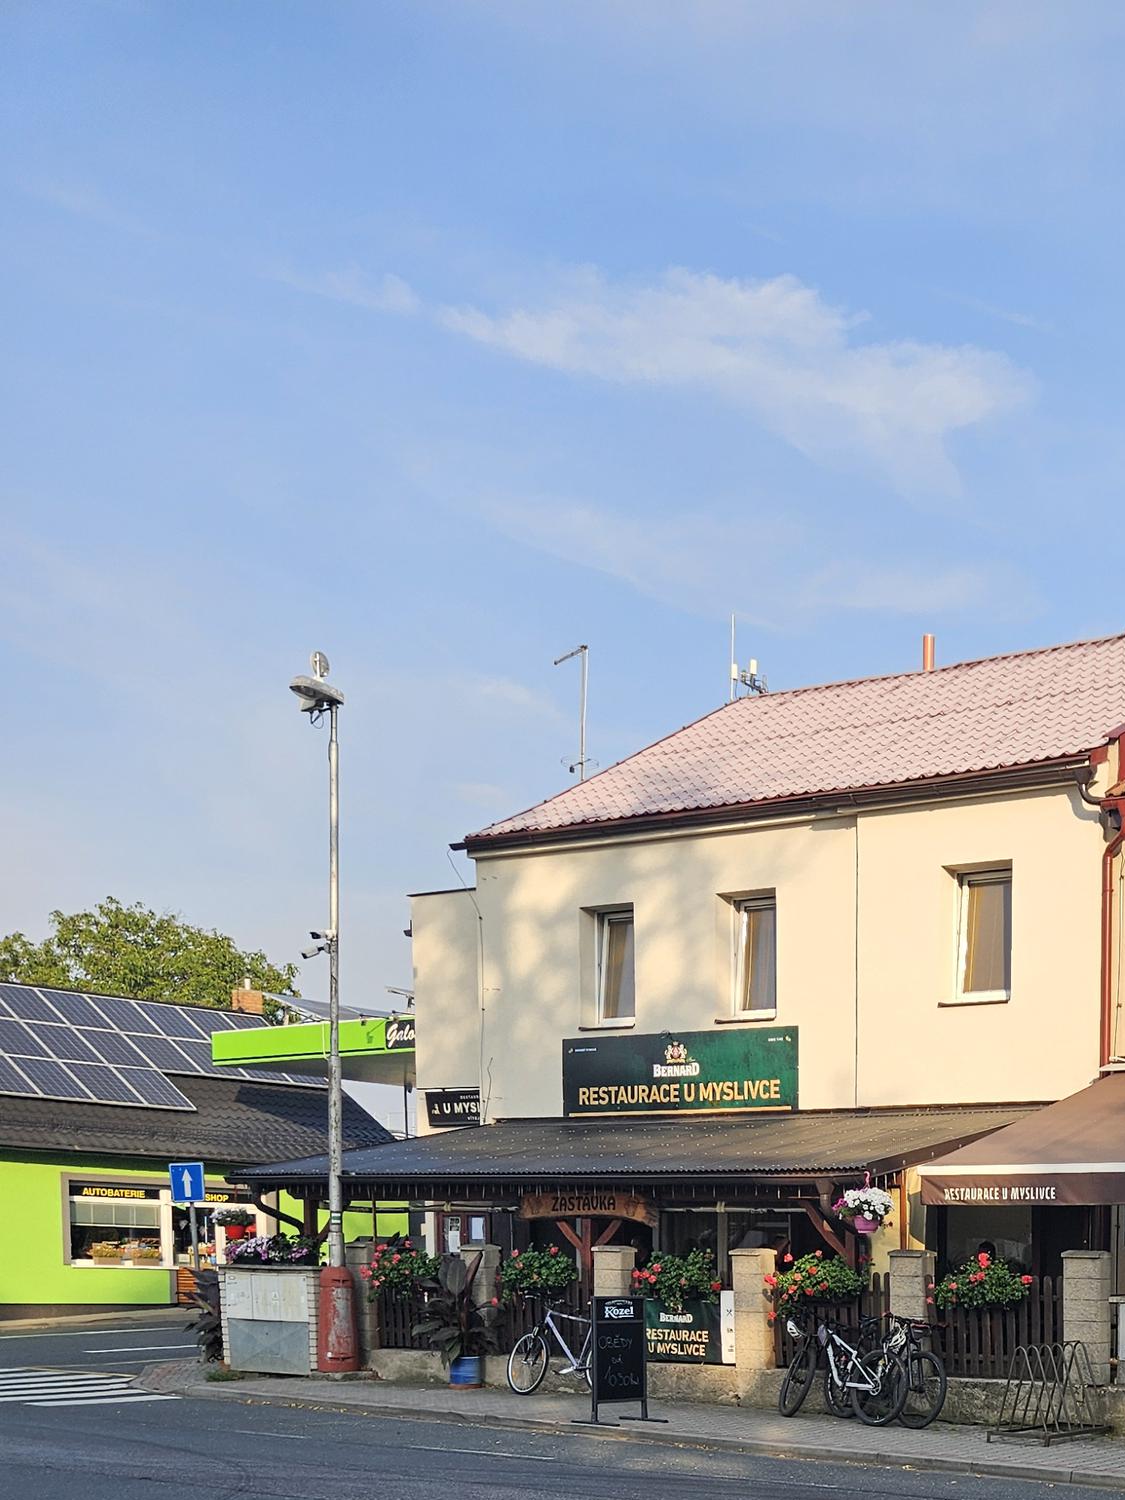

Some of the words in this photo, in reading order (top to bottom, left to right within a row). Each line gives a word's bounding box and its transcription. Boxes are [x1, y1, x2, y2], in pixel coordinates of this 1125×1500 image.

[653, 1062, 700, 1078] BERNARD
[579, 1083, 680, 1105] RESTAURACE
[684, 1083, 695, 1102] U
[700, 1079, 780, 1101] MYSLIVCE
[443, 1102, 451, 1114] U
[82, 1187, 146, 1199] AUTOBATERIE
[205, 1193, 229, 1203] SHOP
[944, 1187, 1000, 1201] RESTAURACE
[1002, 1187, 1008, 1200] U
[1010, 1187, 1056, 1200] MYSLIVCE
[604, 1306, 634, 1319] Kozel
[646, 1328, 709, 1343] RESTAURACE
[647, 1342, 655, 1353] U
[657, 1342, 706, 1356] MYSLIVCE
